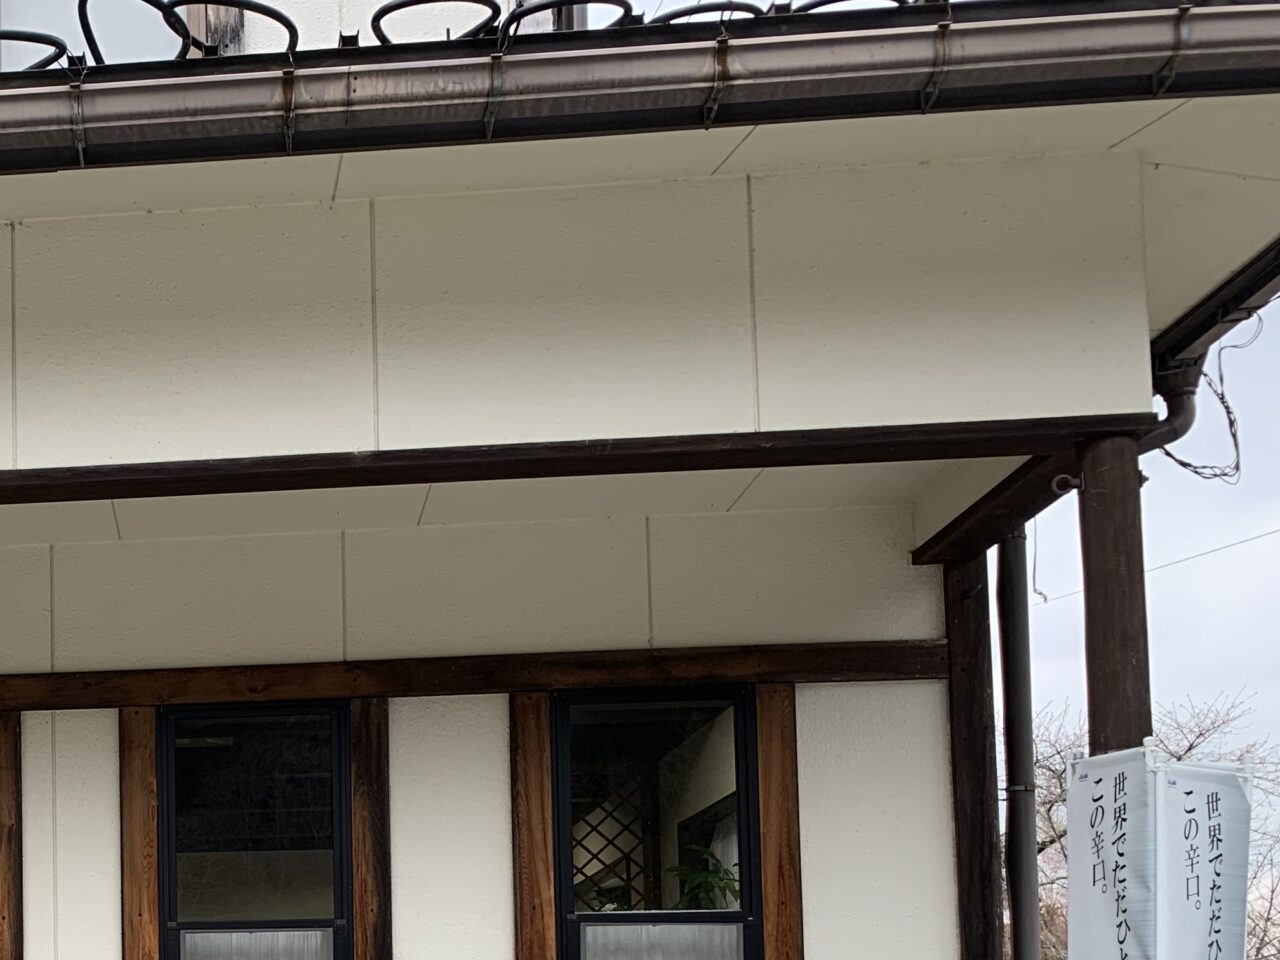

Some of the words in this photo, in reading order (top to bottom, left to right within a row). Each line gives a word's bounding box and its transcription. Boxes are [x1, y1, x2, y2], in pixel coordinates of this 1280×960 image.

[1089, 777, 1108, 894] この辛口。
[1183, 790, 1202, 910] この辛口。
